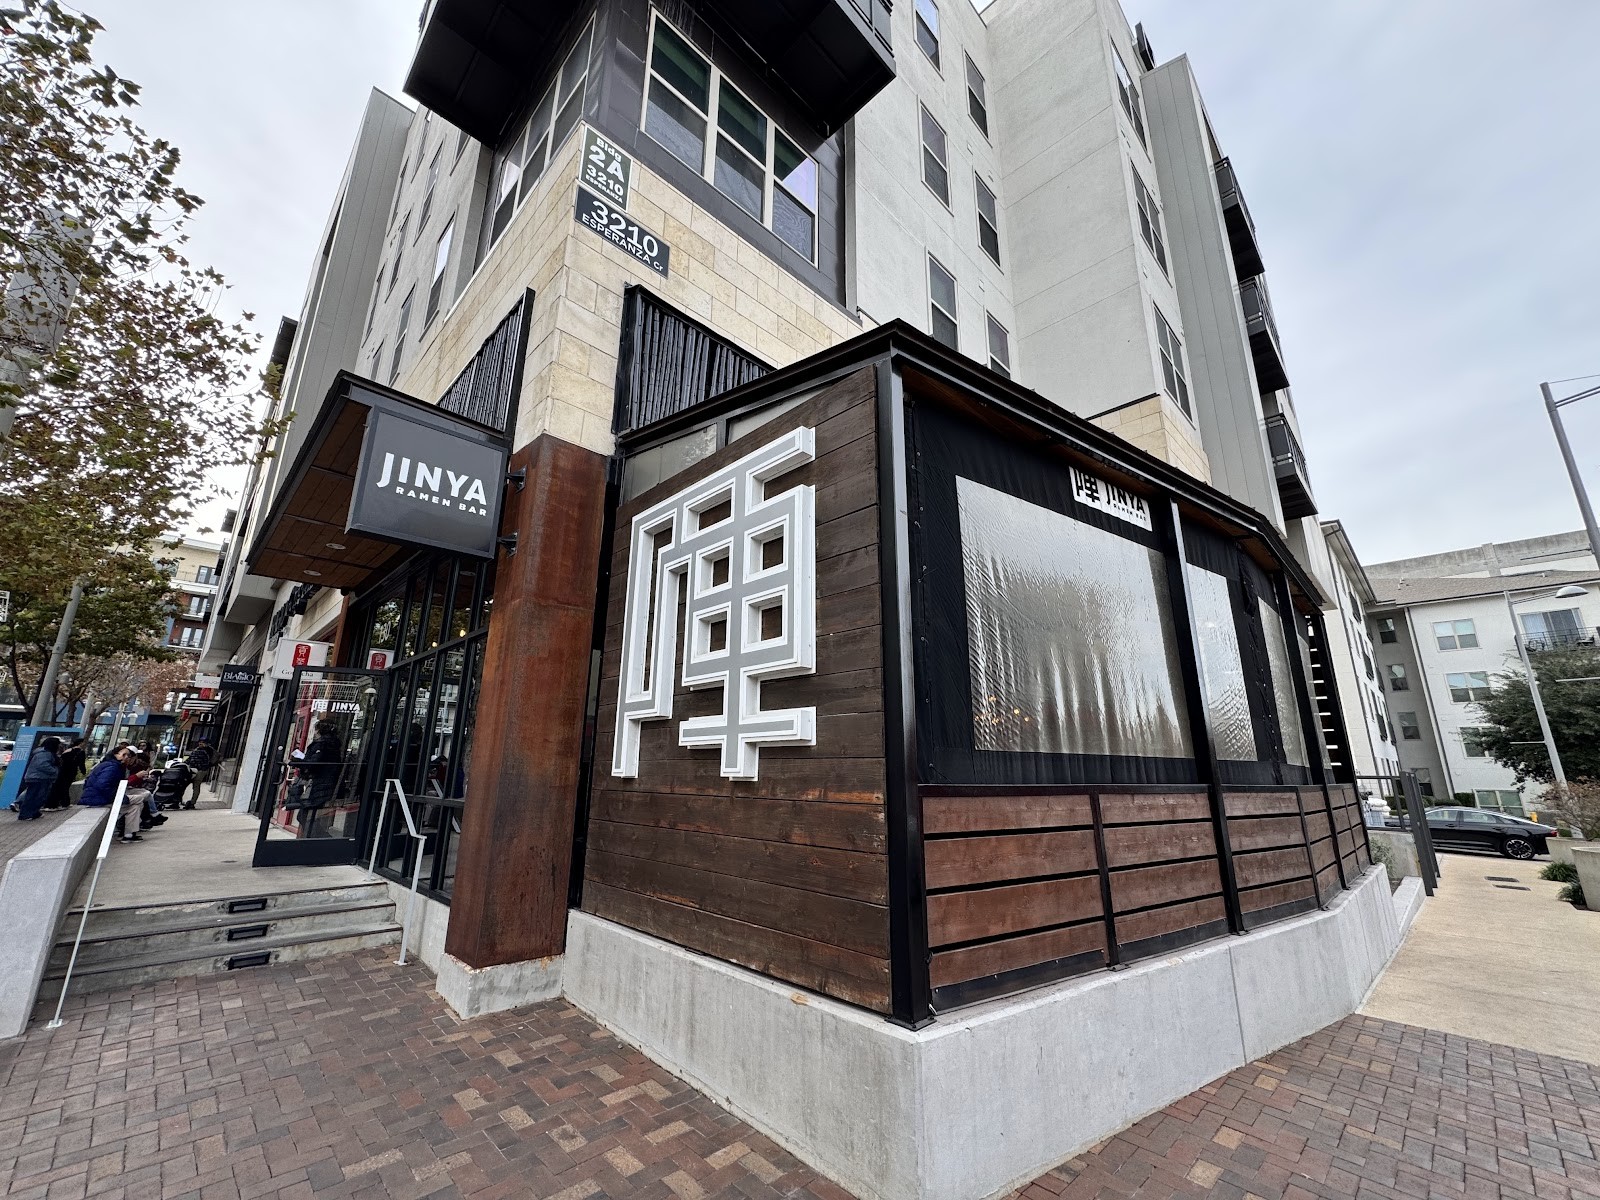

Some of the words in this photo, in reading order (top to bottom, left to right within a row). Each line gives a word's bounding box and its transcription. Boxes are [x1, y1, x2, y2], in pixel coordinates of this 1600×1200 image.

[596, 137, 622, 162] Bldg
[585, 174, 623, 203] ESPERANZA
[586, 164, 624, 196] 3210
[582, 213, 651, 265] ESPERANZA
[591, 200, 658, 258] 3210
[376, 452, 487, 505] JINYA
[395, 486, 451, 507] RAMEN
[458, 503, 487, 516] BAR
[1105, 482, 1146, 515] JINYA
[331, 701, 361, 713] JINYA
